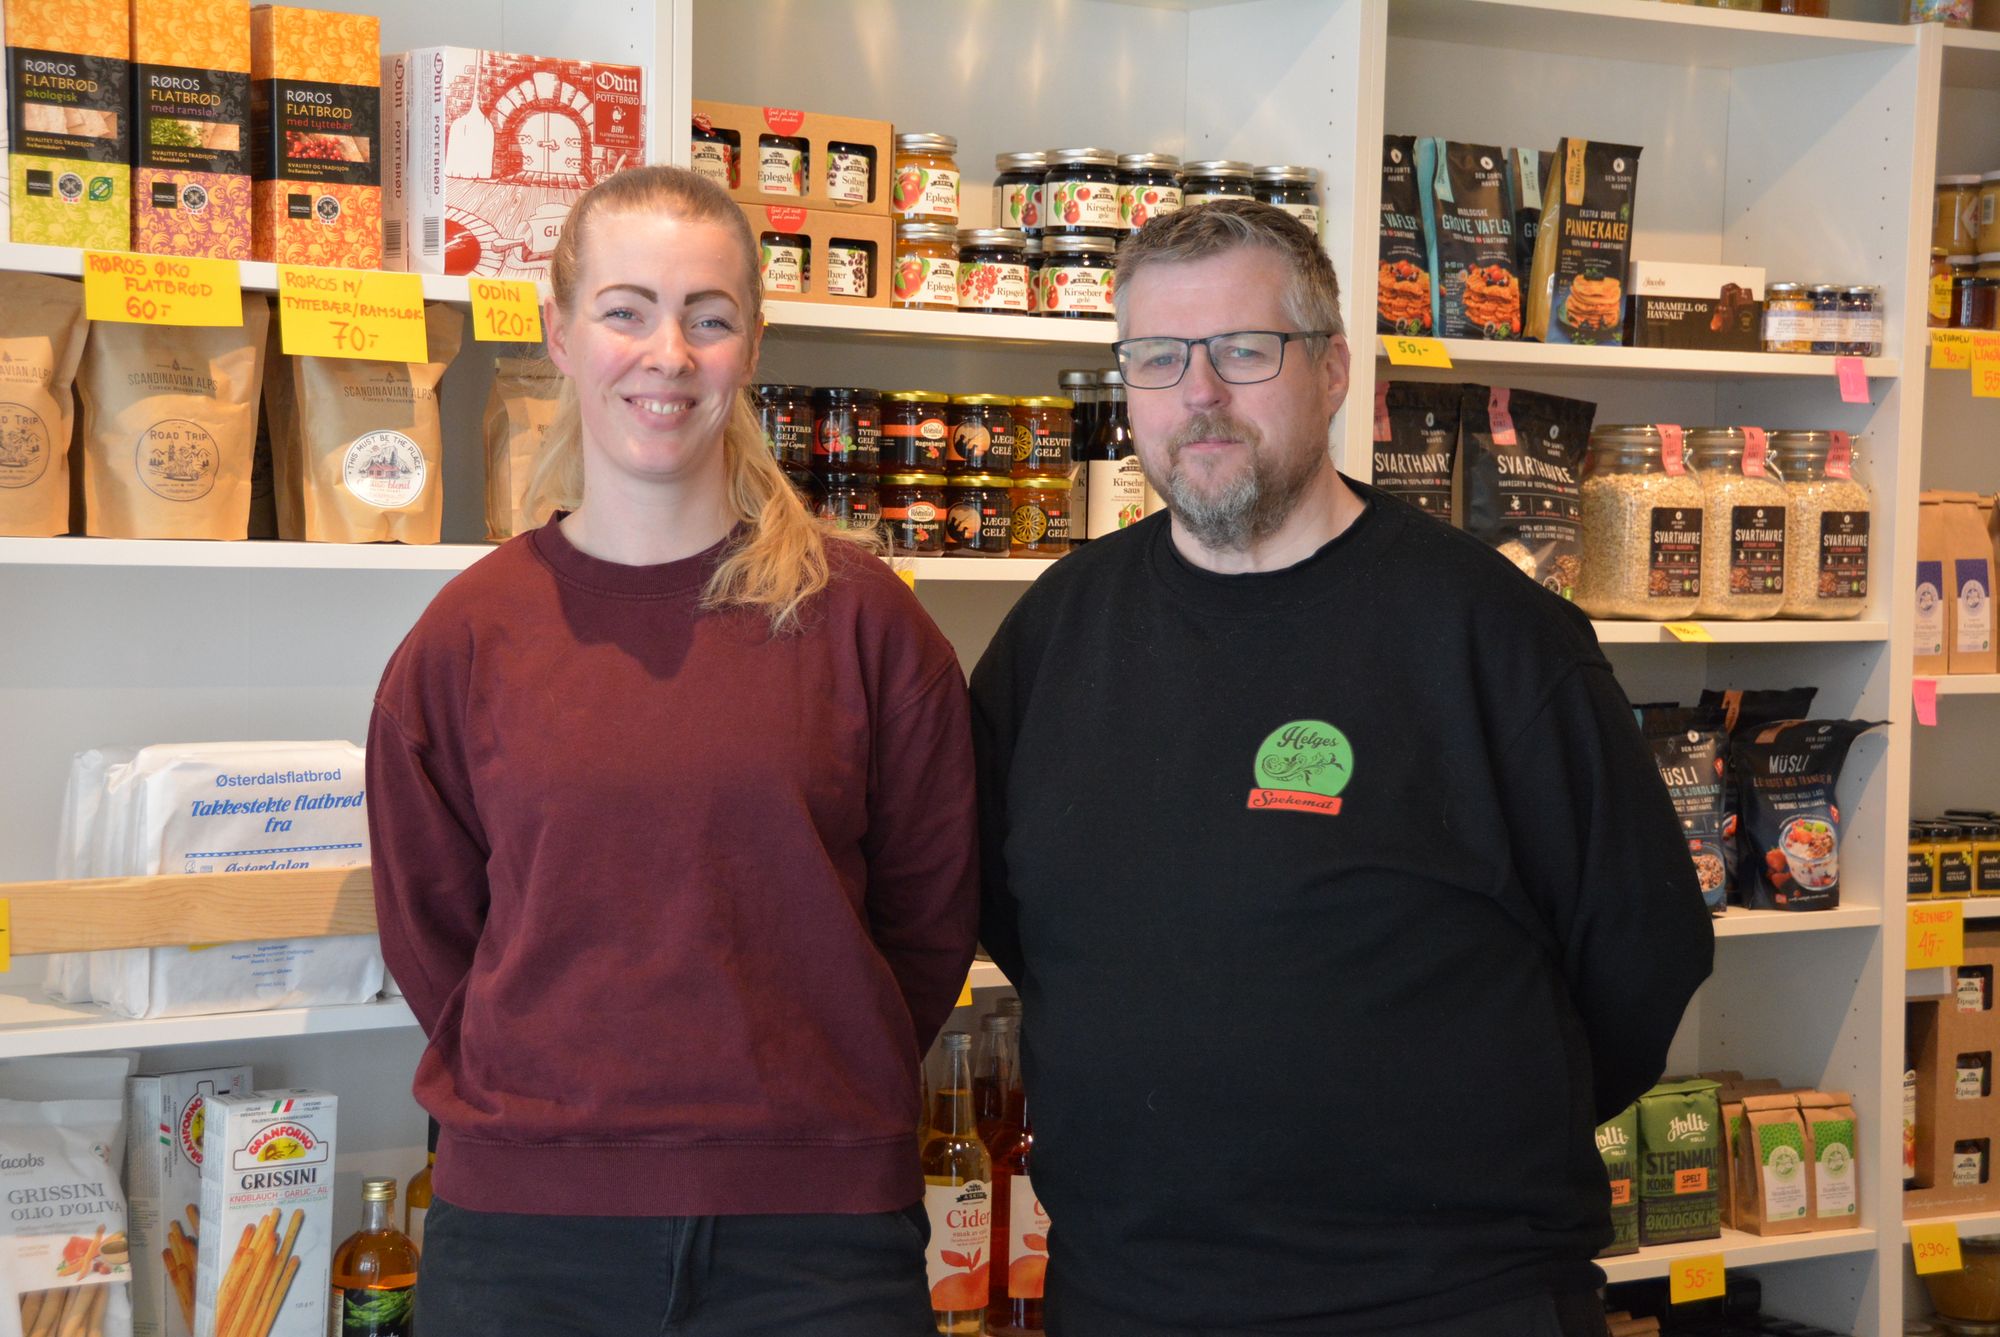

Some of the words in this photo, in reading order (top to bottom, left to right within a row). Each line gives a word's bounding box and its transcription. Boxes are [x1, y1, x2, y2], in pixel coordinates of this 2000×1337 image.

[25, 59, 77, 77] RØROS
[25, 73, 99, 93] FLATBRØD
[151, 75, 200, 91] RØROS
[394, 58, 405, 109] Odin
[432, 52, 444, 104] Odin
[596, 71, 639, 93] Odin
[25, 89, 79, 103] økologisk
[151, 89, 221, 107] FLATBRØD
[287, 90, 333, 105] RØROS
[595, 93, 640, 106] POTETBRØD
[151, 104, 175, 114] med
[177, 106, 219, 118] ramsløk
[287, 104, 353, 119] FLATBRØD
[287, 118, 309, 129] med
[311, 119, 353, 132] tyttebær
[395, 121, 403, 199] POTETBRØD
[434, 116, 442, 196] POTETBRØD
[757, 170, 793, 184] Eplegelé
[1384, 213, 1418, 230] VAFLER
[1580, 209, 1599, 219] EKSTRA
[1600, 210, 1617, 220] GROVE
[1442, 214, 1473, 233] GROVE
[88, 253, 146, 277] RØROS
[153, 258, 190, 279] ØKO
[124, 276, 212, 298] FLATBRØD
[285, 271, 337, 292] RØROS
[1064, 287, 1102, 298] Kirsebær
[283, 296, 424, 321] TYTTEBÆR/RAMSLØK
[1647, 301, 1694, 312] KARAMELL
[1694, 303, 1708, 313] OG
[1647, 310, 1685, 321] HAVSALT
[127, 372, 194, 388] SCANDINAVIAN
[195, 376, 218, 392] ALPS
[343, 384, 408, 398] SCANDINAVIAN
[412, 387, 432, 401] ALPS
[150, 429, 180, 441] ROAD
[185, 431, 208, 441] TRIP
[775, 432, 798, 441] GELÉ
[857, 435, 875, 445] GELÉ
[347, 452, 359, 469] THIS
[356, 436, 376, 452] MUST
[379, 434, 390, 442] BE
[392, 435, 408, 447] THE
[407, 445, 422, 470] PLACE
[991, 445, 1013, 456] GELÉ
[1034, 446, 1061, 457] GELÉ
[1497, 454, 1575, 484] SVARTHAVRE
[982, 527, 1007, 537] GELÉ
[1048, 528, 1070, 538] GELÉ
[1654, 531, 1700, 545] SVARTHAVRE
[1735, 528, 1783, 542] SVARTHAVRE
[1823, 534, 1868, 547] SVARTHAVRE
[1276, 726, 1338, 750] Helges
[1769, 754, 1810, 774] MÜSLI
[216, 769, 341, 789] Østerdalsflatbrød
[191, 798, 290, 817] Takkestekte
[293, 791, 364, 812] flatbrød
[1253, 791, 1335, 809] Spekemat
[265, 817, 293, 833] fra
[1913, 909, 1953, 924] SENNEP
[182, 1097, 204, 1164] GRANFORNO
[1668, 1113, 1711, 1142] Holli
[249, 1126, 314, 1156] GRANFORNO
[241, 1168, 317, 1190] GRISSINI
[1647, 1178, 1672, 1191] KORN
[1682, 1173, 1701, 1184] SPELT
[7, 1183, 105, 1205] GRISSINI
[230, 1193, 278, 1203] KNOBLAUCH
[284, 1189, 310, 1198] GARLIC
[10, 1206, 54, 1221] OLIO
[60, 1201, 122, 1217] D'OLIVA
[946, 1208, 991, 1229] Cider
[1646, 1211, 1708, 1232] ØKOLOGISK
